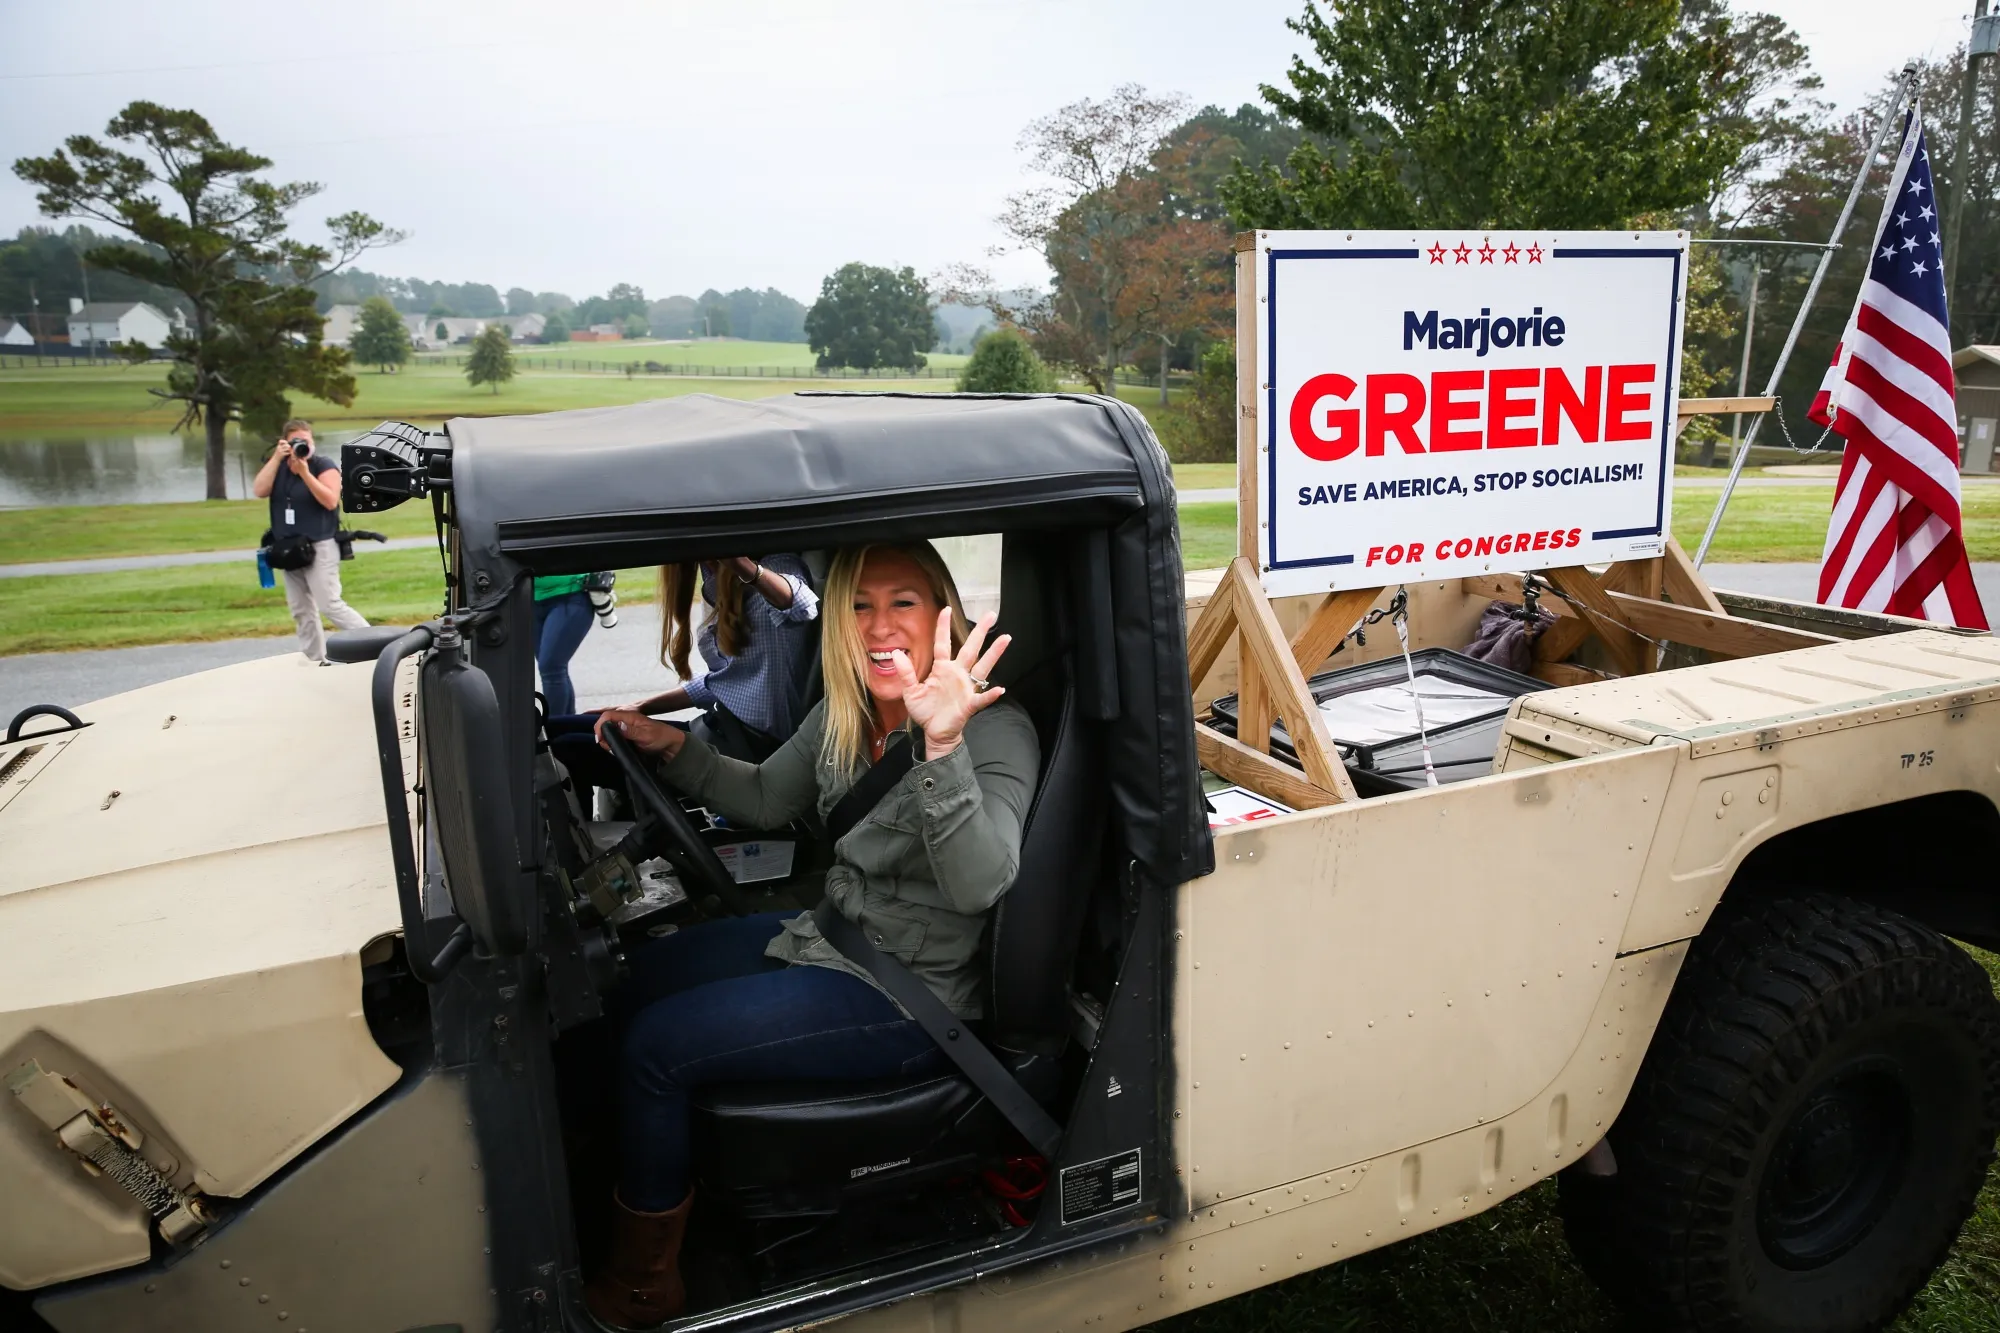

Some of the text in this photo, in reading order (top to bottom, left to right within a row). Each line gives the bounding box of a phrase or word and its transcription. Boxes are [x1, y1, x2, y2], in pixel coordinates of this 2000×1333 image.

[1404, 306, 1566, 358] Marjorie
[1289, 363, 1657, 462] GREENE
[1298, 463, 1644, 505] SAVE AMERICA, STOP SOCIALISM!
[1365, 528, 1582, 568] FOR CONGRESS
[1900, 750, 1935, 769] TP 25
